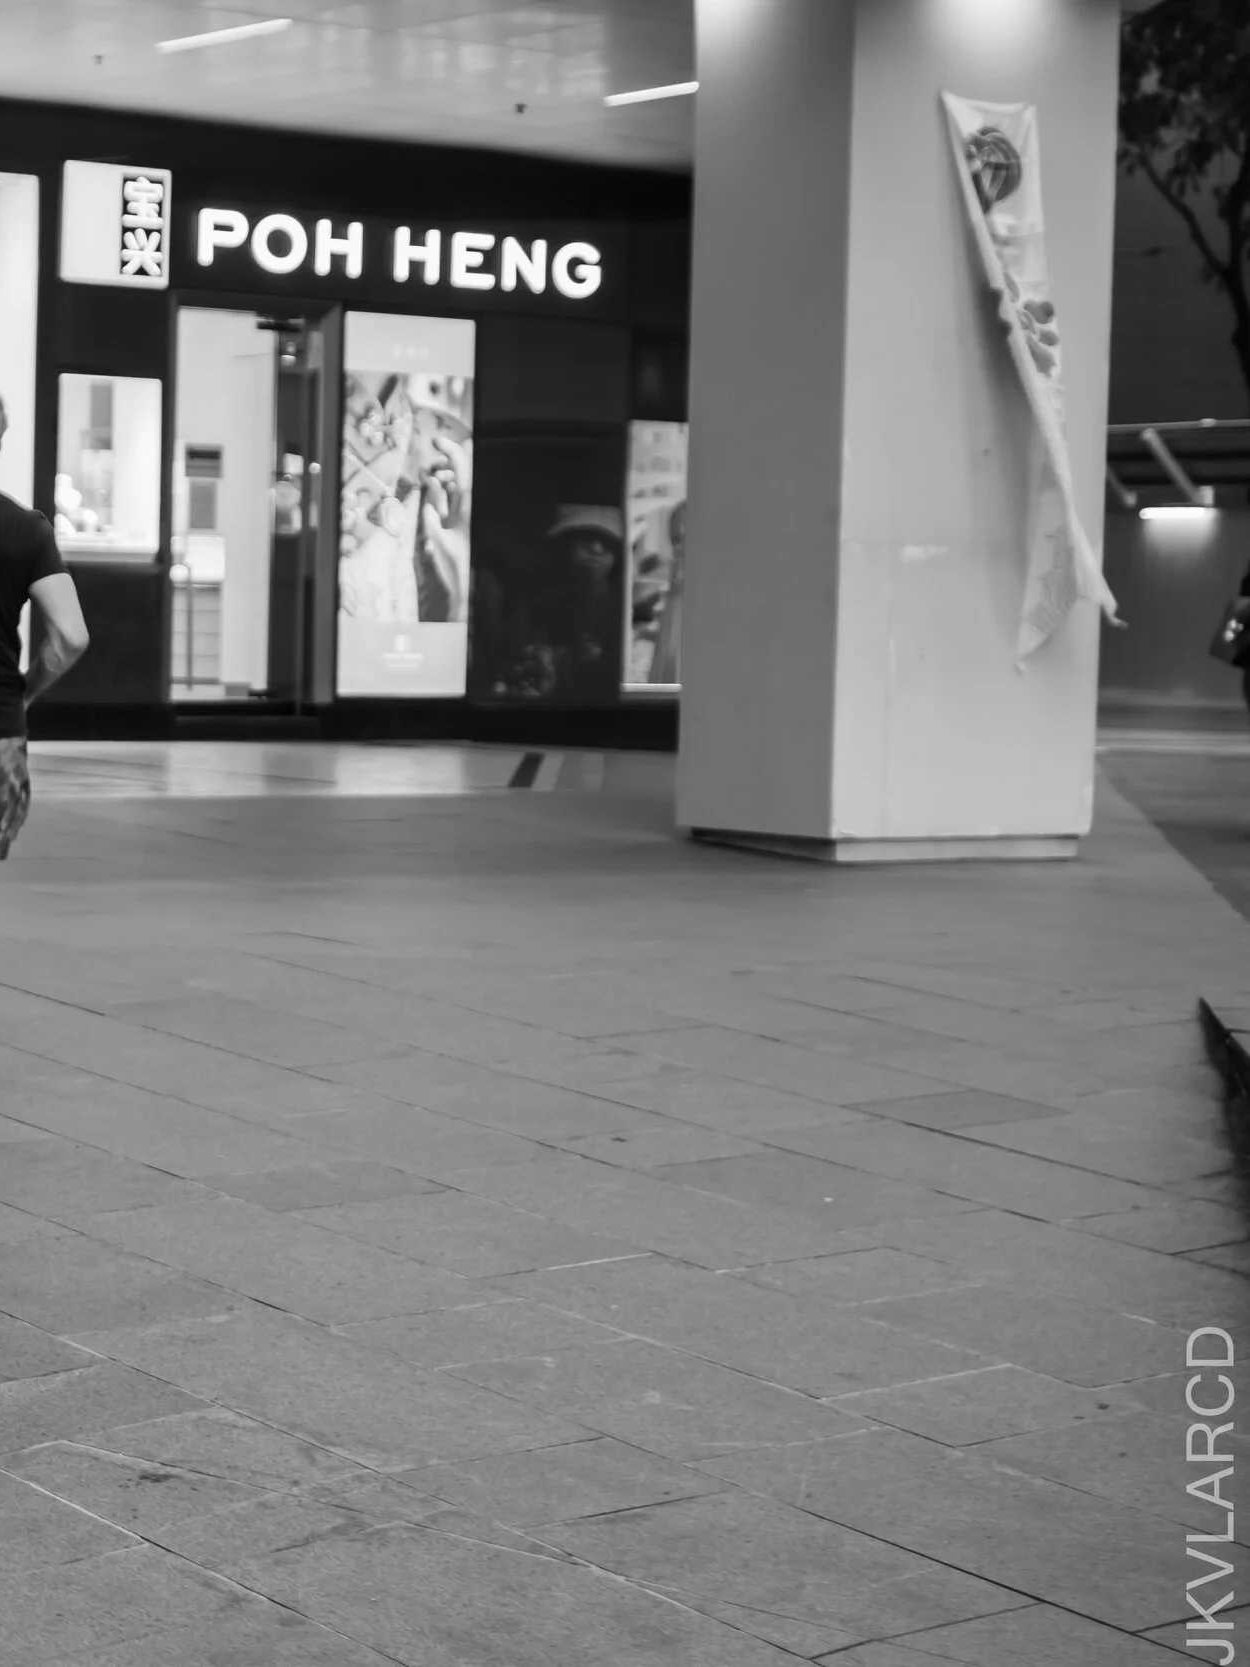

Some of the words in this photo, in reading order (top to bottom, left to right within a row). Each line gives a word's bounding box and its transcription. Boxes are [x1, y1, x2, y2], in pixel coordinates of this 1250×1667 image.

[121, 176, 164, 277] 宝兴
[196, 207, 365, 279] POH
[392, 225, 603, 299] HENG
